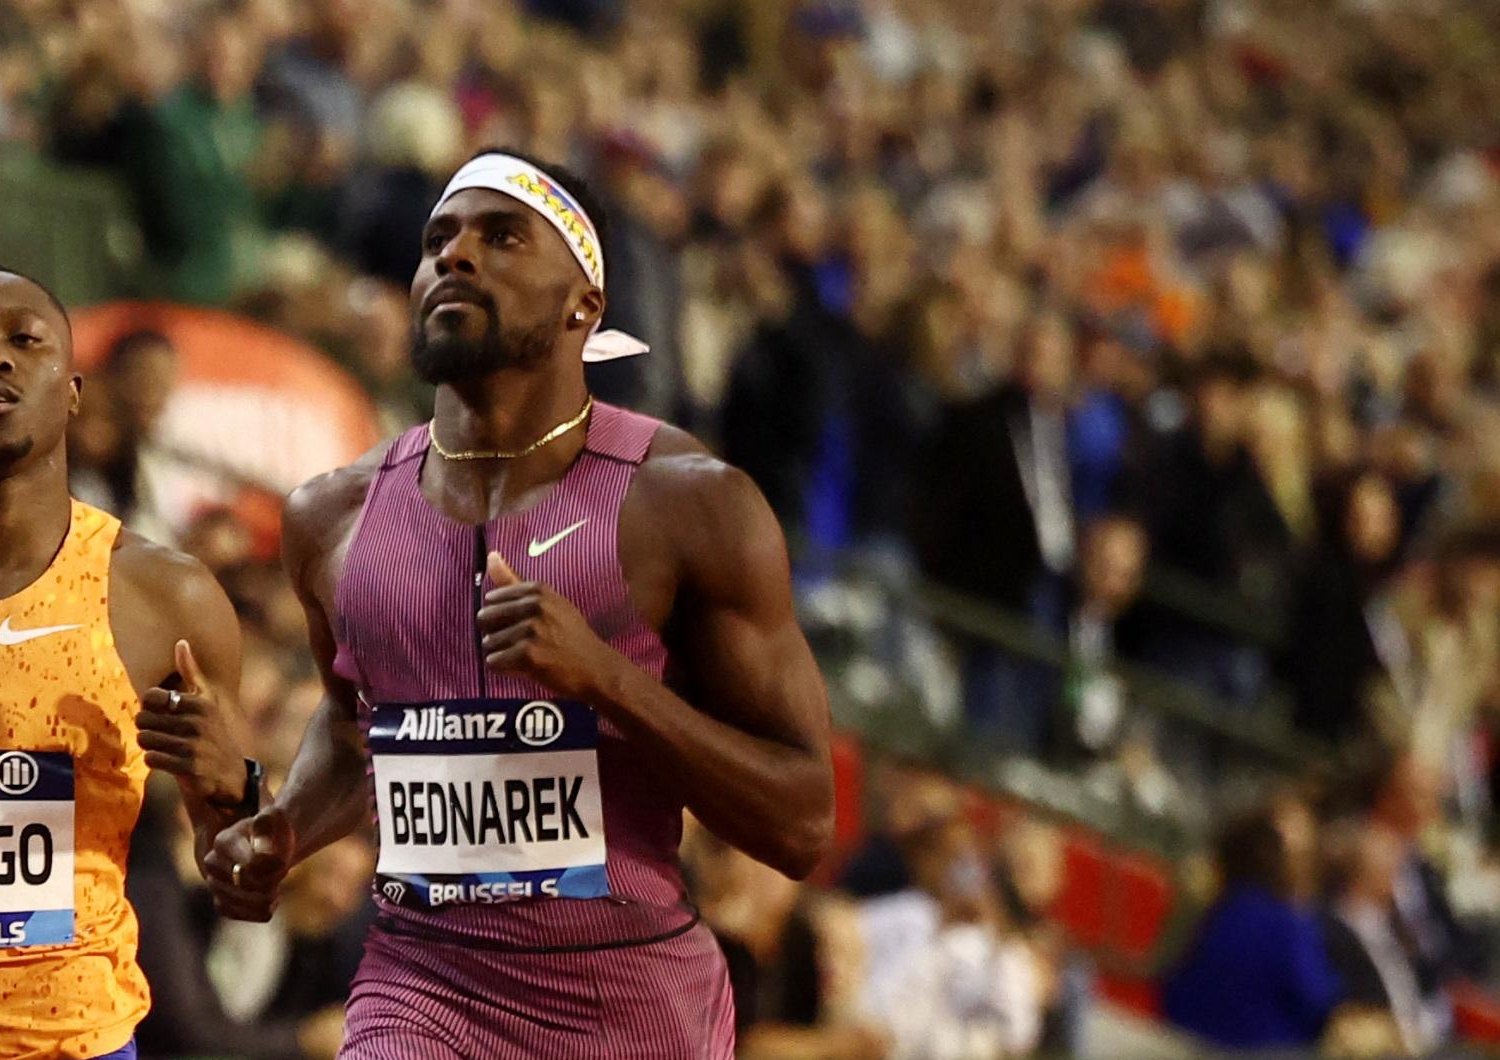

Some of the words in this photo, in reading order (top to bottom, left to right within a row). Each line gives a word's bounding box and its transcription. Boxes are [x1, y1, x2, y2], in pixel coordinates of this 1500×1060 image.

[395, 707, 507, 741] Allianz
[389, 776, 590, 846] BEDNAREK
[428, 878, 559, 907] BRUSSELS
